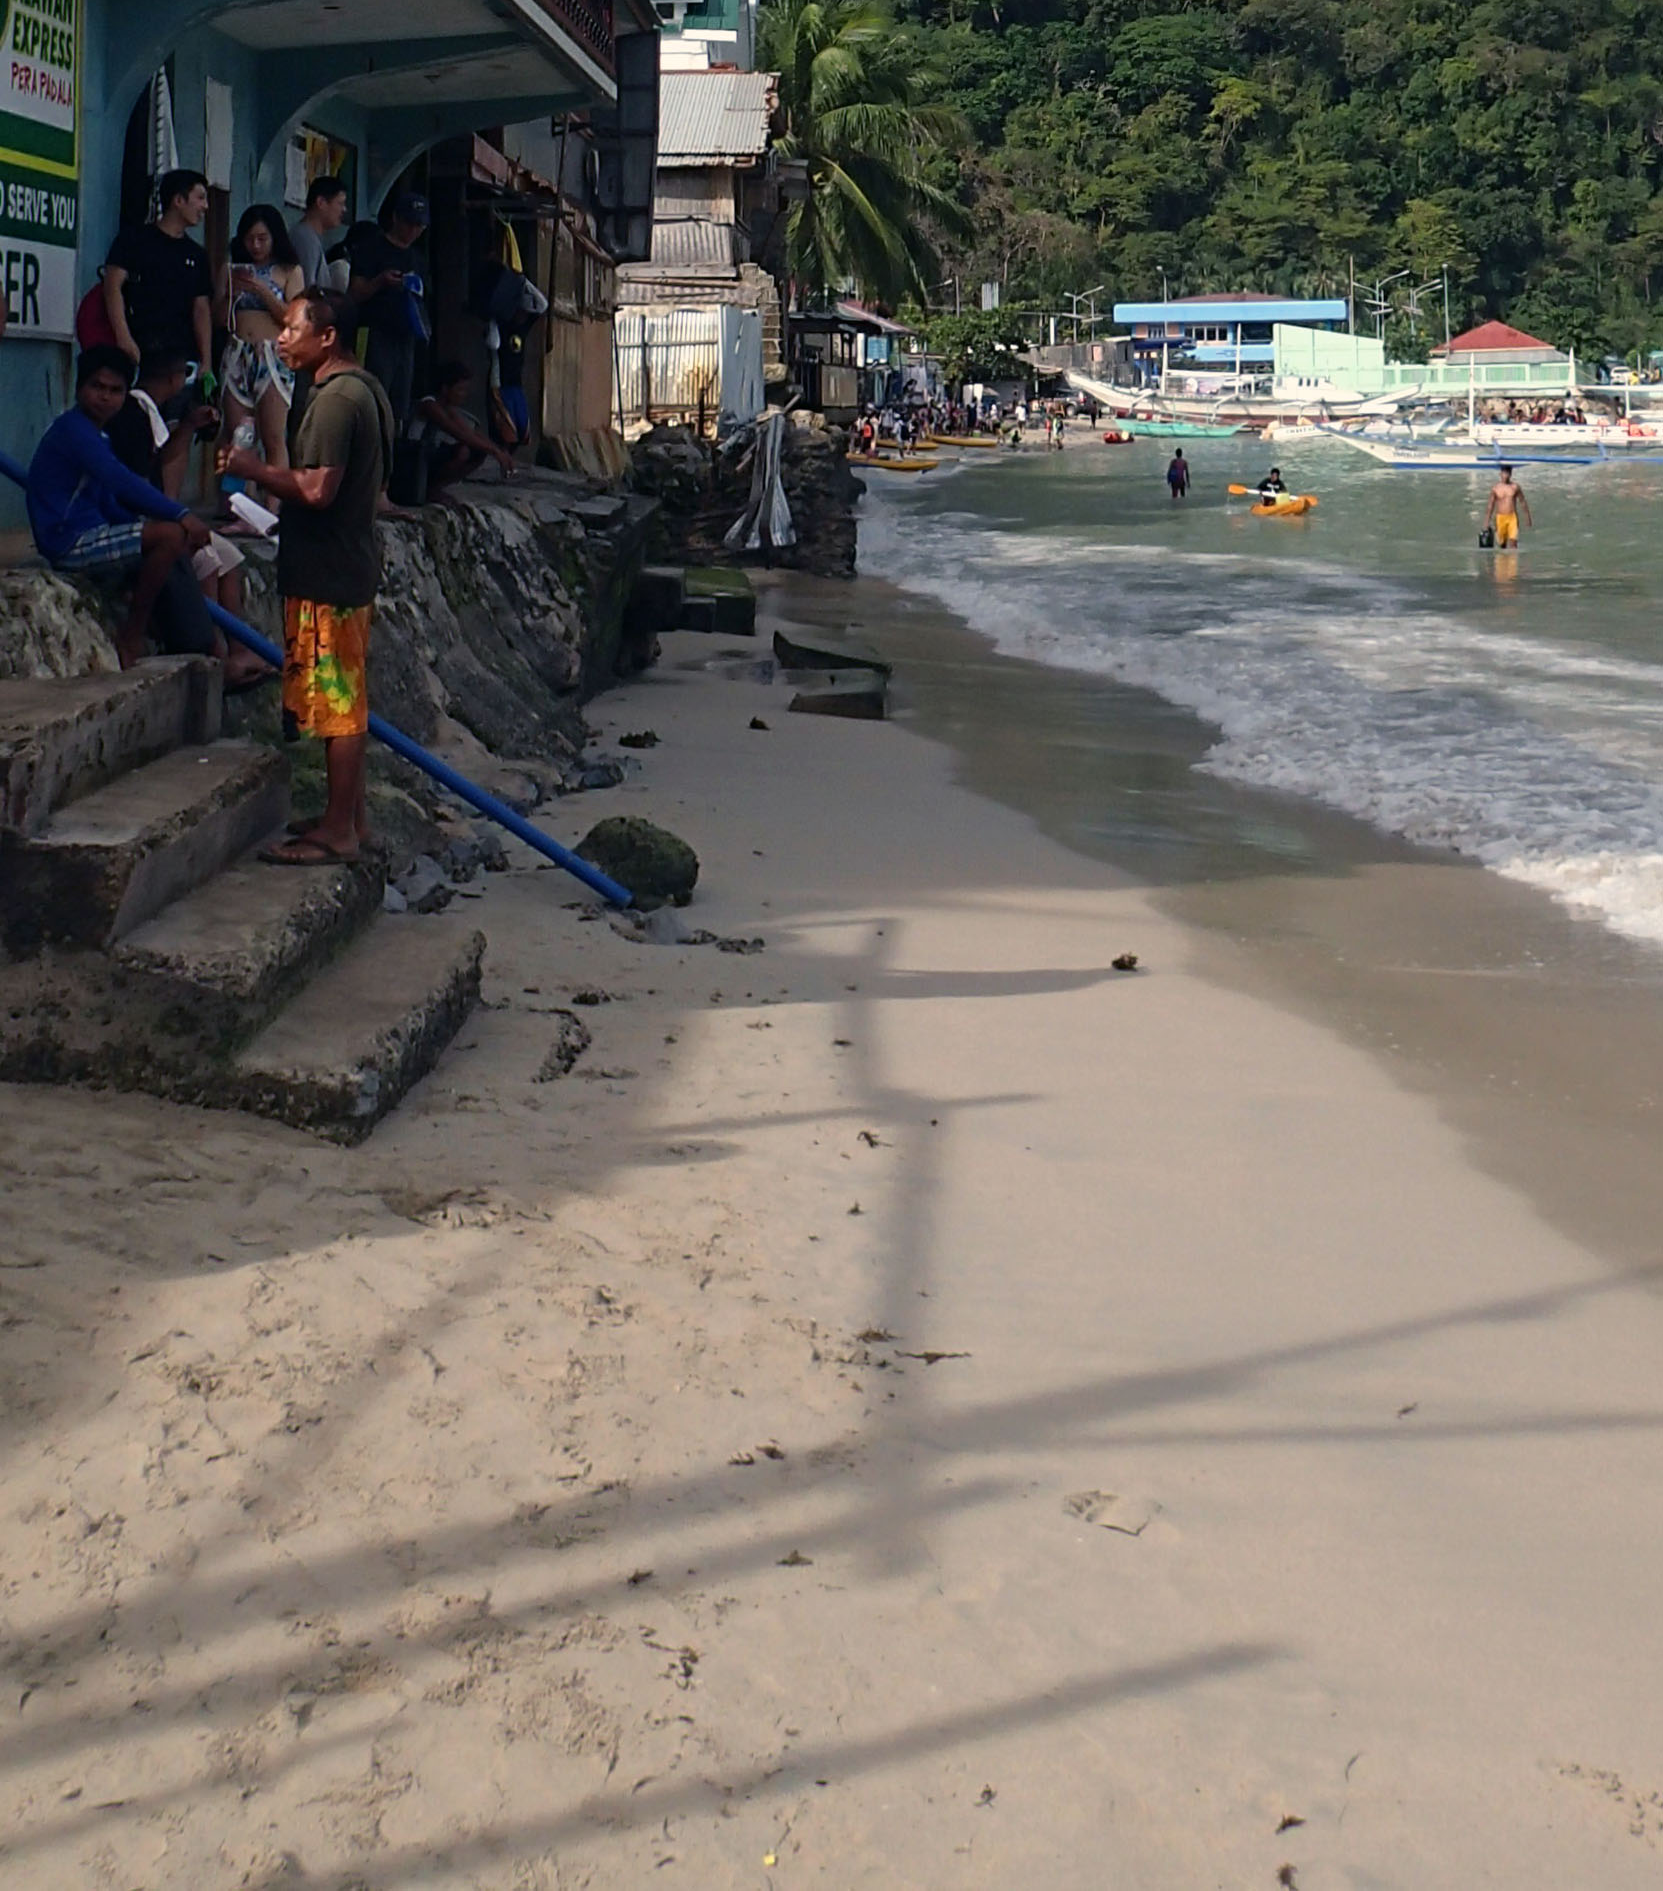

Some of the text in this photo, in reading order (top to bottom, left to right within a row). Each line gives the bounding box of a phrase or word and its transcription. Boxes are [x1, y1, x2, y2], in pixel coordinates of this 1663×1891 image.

[12, 11, 73, 72] EXPRESS
[10, 62, 72, 108] PERA PADALA
[8, 183, 48, 225] SERVE
[51, 193, 76, 230] YOU
[0, 250, 40, 326] ER
